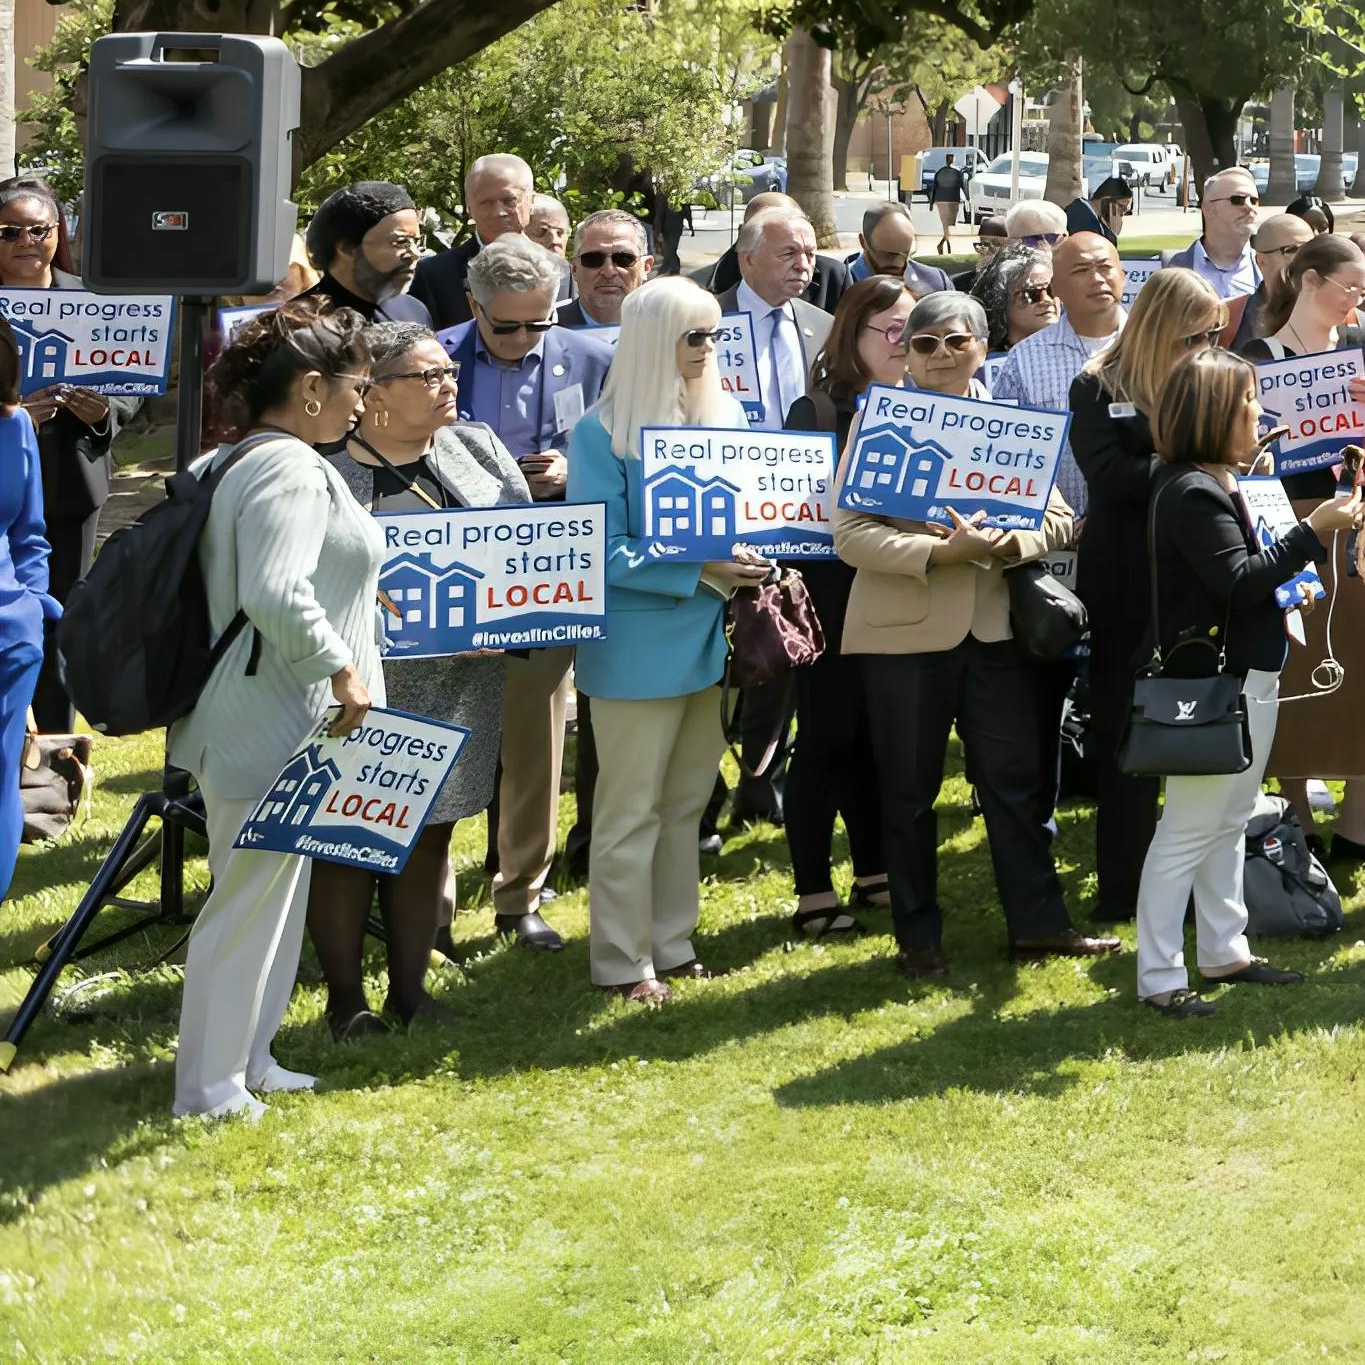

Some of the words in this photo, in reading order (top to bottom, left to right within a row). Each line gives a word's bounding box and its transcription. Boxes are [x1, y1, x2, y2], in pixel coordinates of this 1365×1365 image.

[60, 302, 162, 320] progress
[91, 325, 158, 342] starts
[75, 349, 157, 366] LOCAL
[1260, 361, 1357, 395] progress
[1295, 385, 1358, 411] start
[876, 396, 935, 423] Real
[941, 411, 1054, 441] progress
[1287, 411, 1364, 440] LOCAL
[655, 439, 711, 459] Real
[722, 444, 824, 466] progress
[971, 443, 1045, 469] starts
[758, 473, 826, 494] starts
[949, 468, 1037, 496] LOCAL
[745, 501, 829, 522] LOCAL
[386, 522, 450, 548] Real
[463, 518, 593, 549] progress
[505, 547, 592, 574] starts
[487, 580, 593, 609] LOCAL
[343, 726, 447, 761] progress
[356, 761, 429, 795] starts
[325, 789, 409, 829] LOCAL
